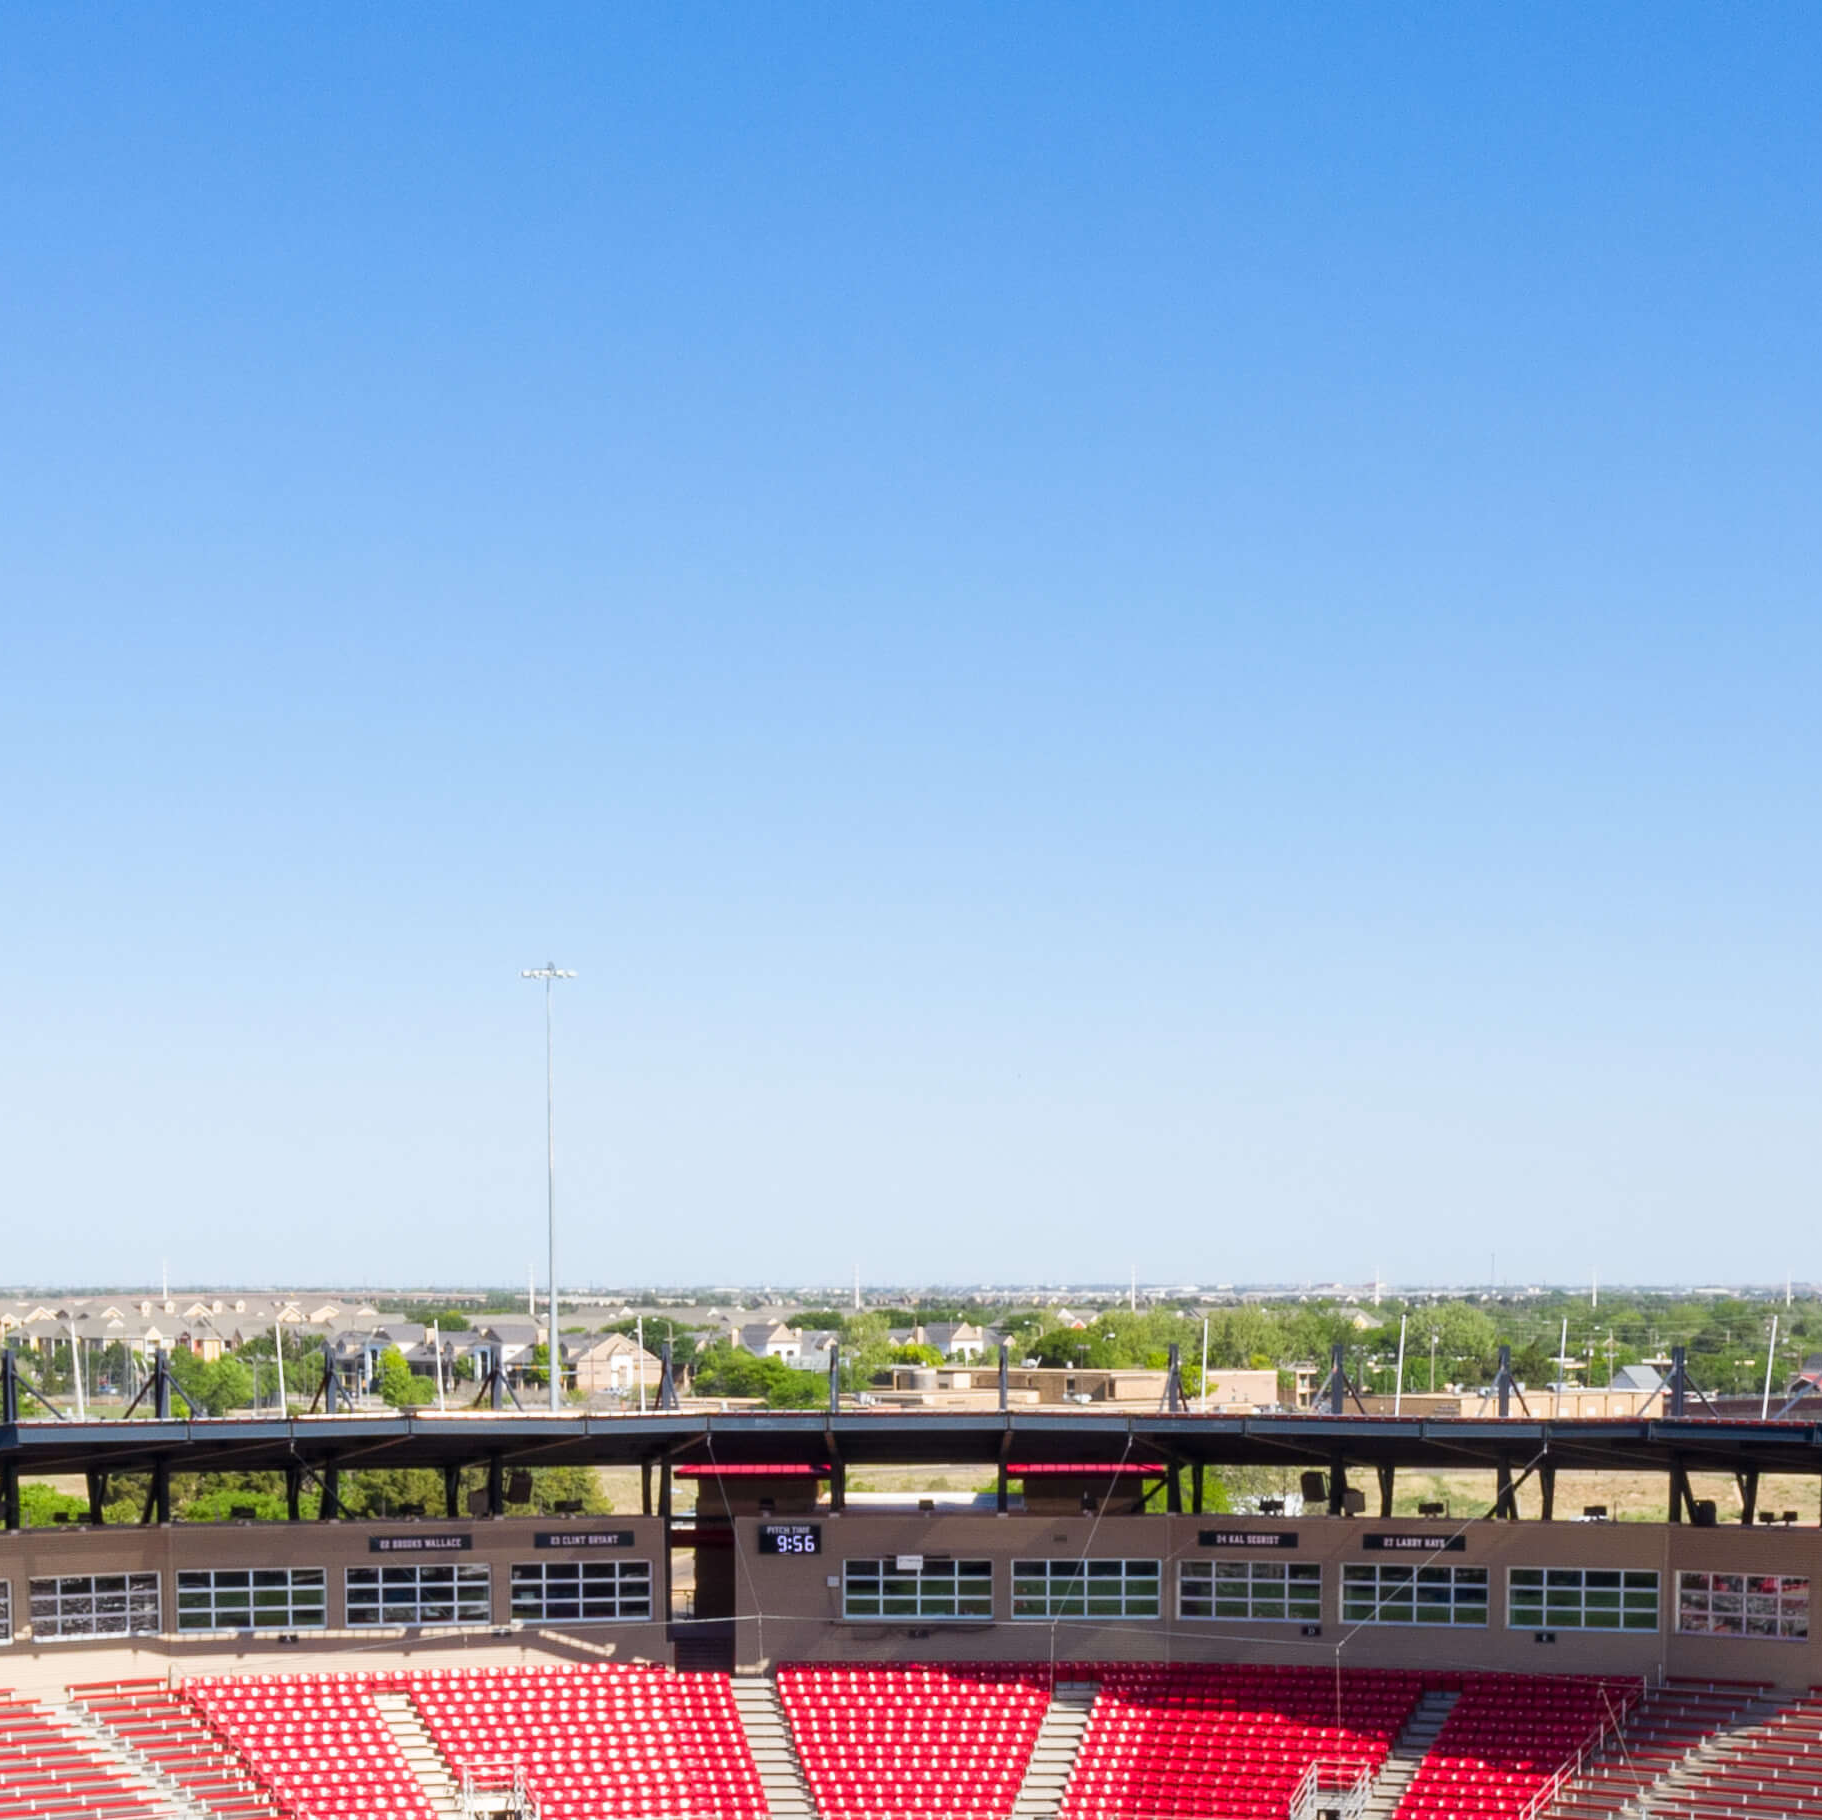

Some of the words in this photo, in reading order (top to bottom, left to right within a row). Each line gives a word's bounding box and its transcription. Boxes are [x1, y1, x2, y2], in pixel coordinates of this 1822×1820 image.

[767, 1526, 790, 1534] PITCH
[792, 1526, 811, 1534] TIME
[424, 1537, 462, 1548] WALLACE
[777, 1535, 815, 1552] 9:56
